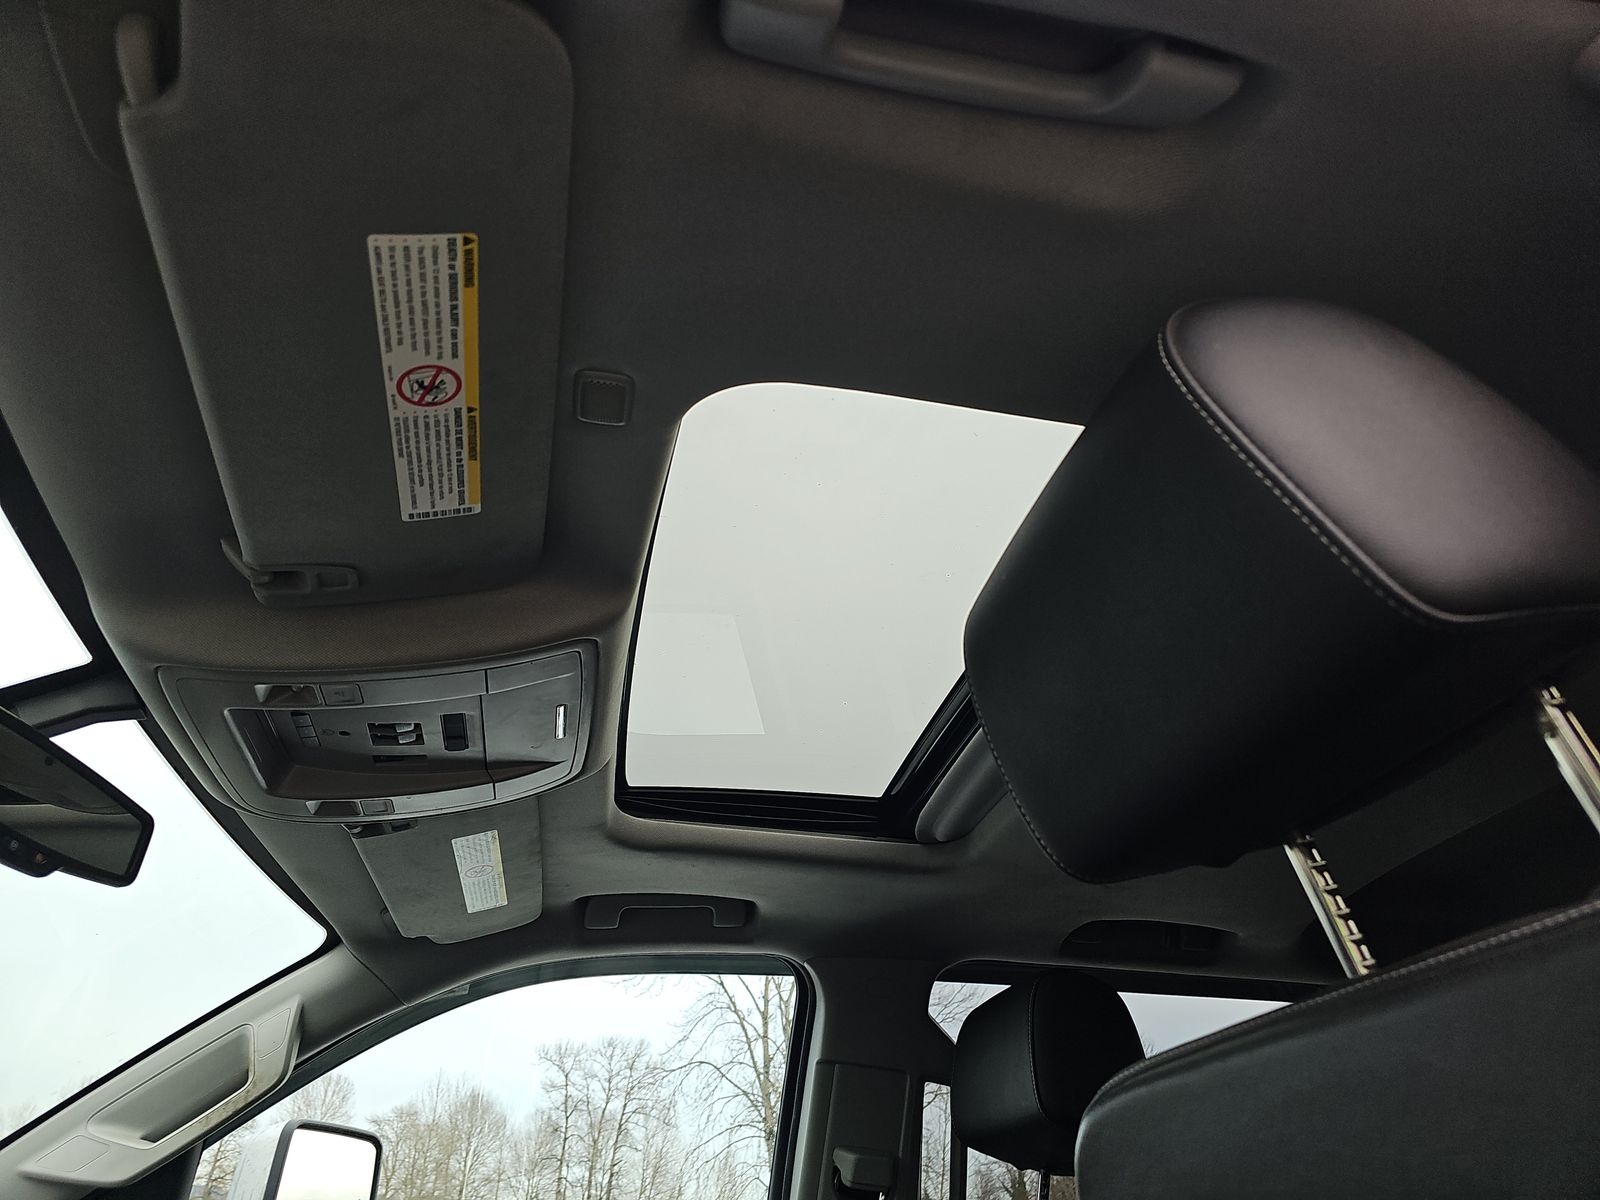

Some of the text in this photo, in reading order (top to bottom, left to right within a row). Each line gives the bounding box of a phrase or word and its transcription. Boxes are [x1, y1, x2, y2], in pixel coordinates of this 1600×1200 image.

[447, 238, 458, 262] DEATH
[448, 264, 456, 272] or
[464, 248, 475, 288] WARNING
[448, 273, 458, 302] SERIOUS
[450, 304, 459, 328] INJURY
[468, 415, 478, 461] AVERTISSEMENT
